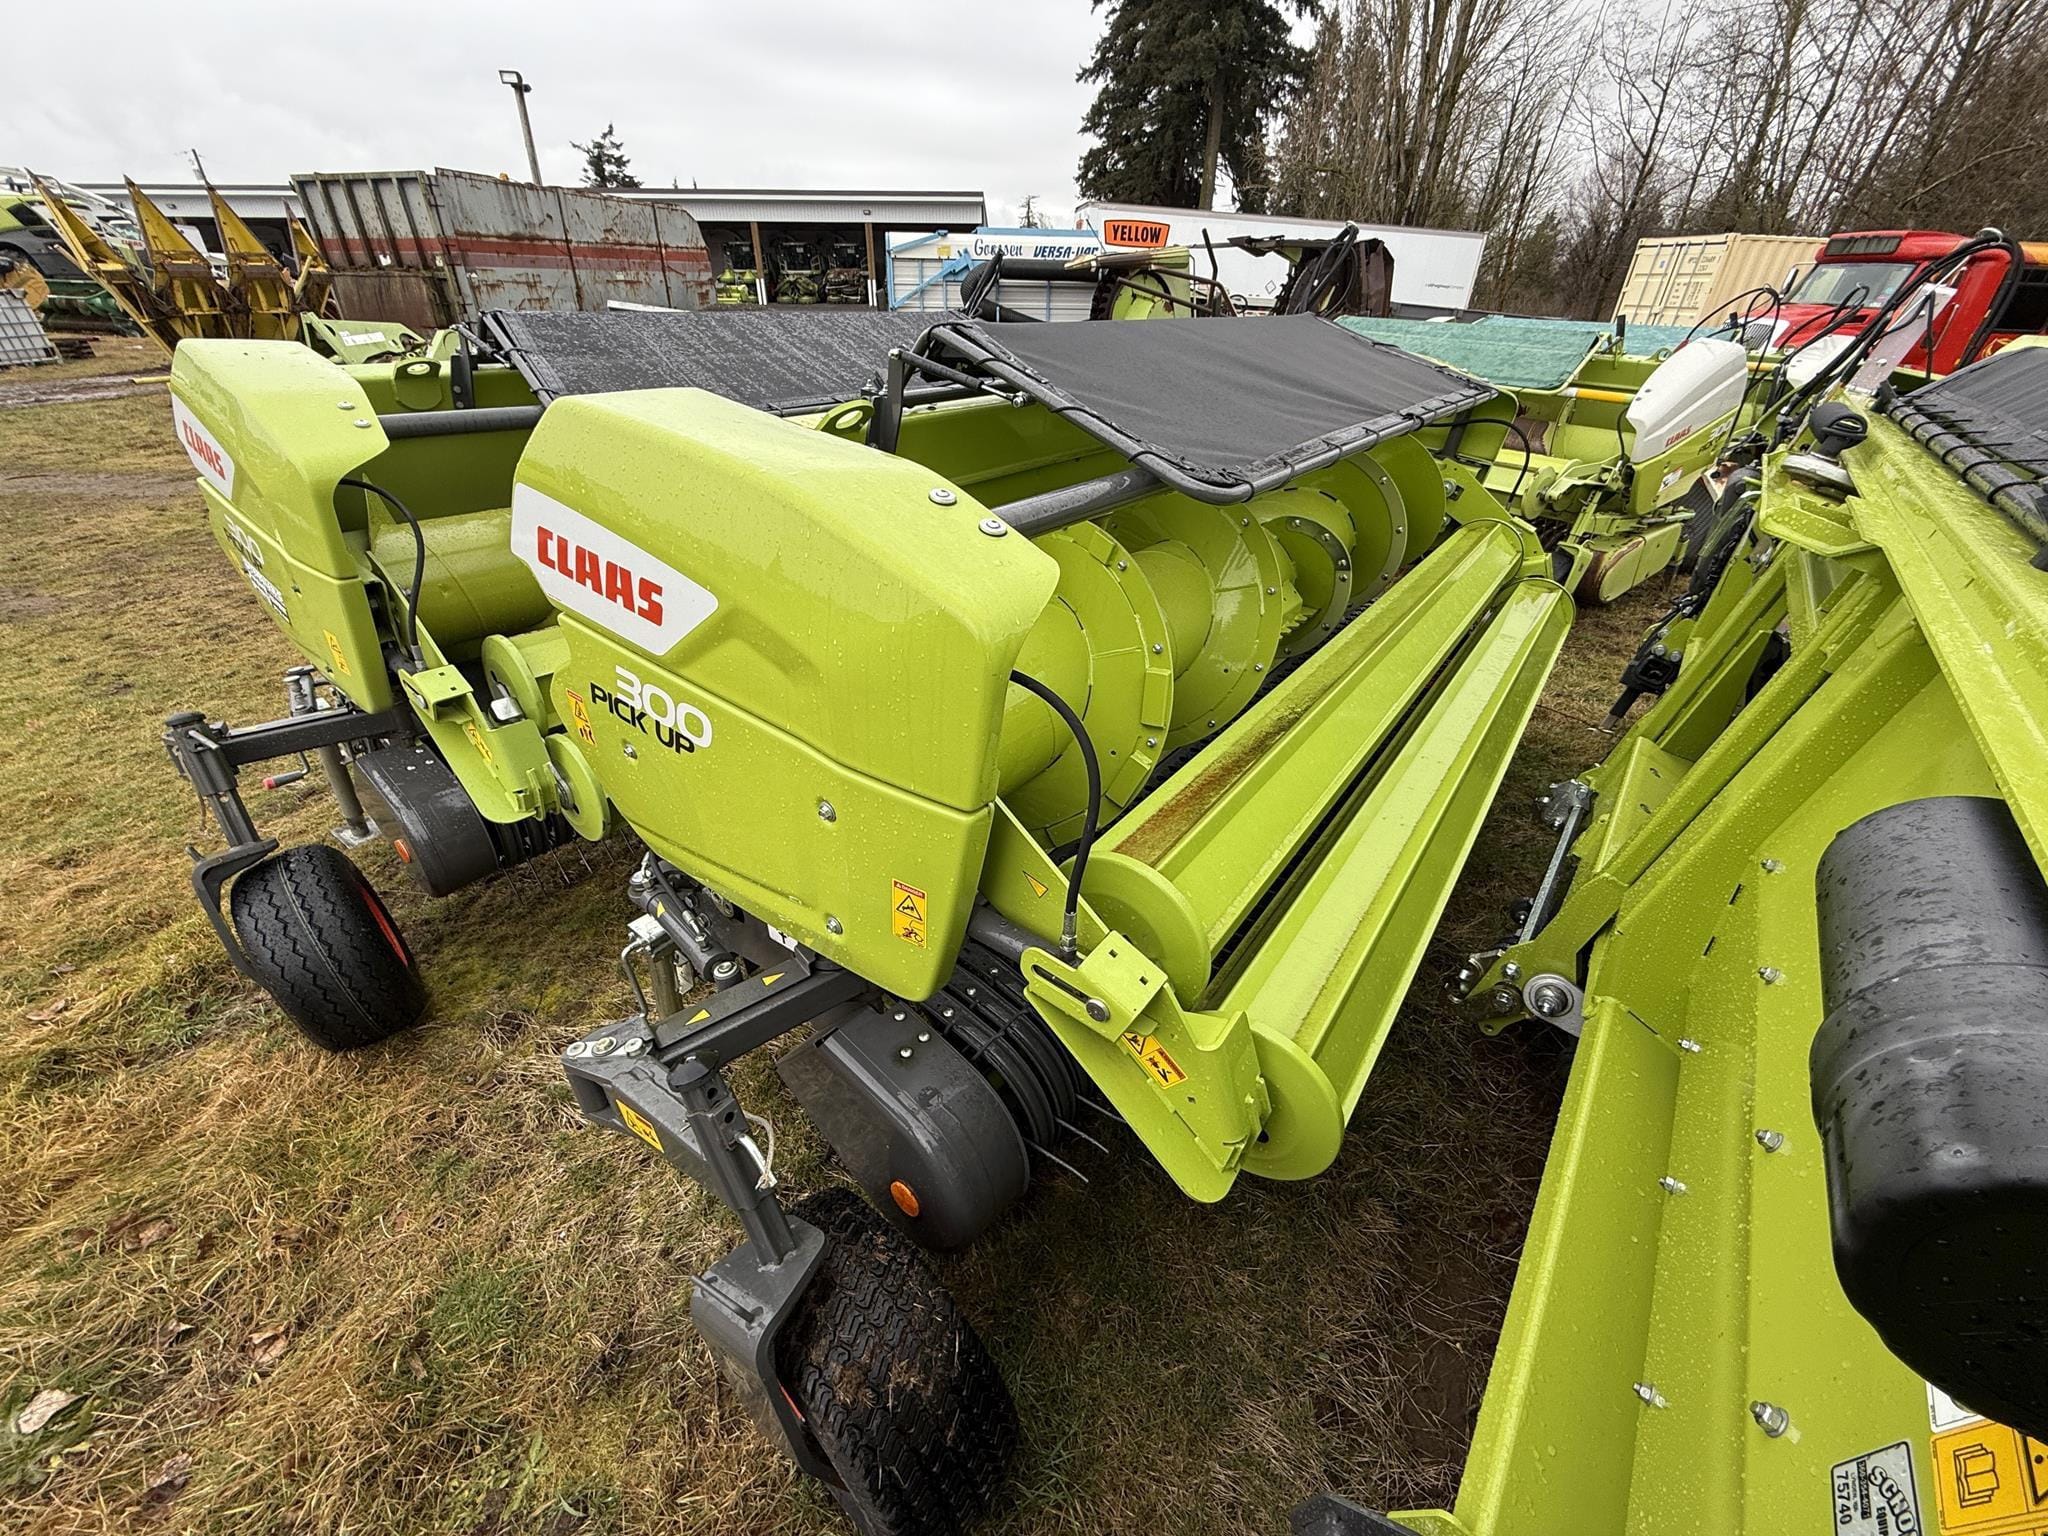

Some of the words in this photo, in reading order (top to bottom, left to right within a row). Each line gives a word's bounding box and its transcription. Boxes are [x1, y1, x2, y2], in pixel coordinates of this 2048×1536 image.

[1112, 224, 1162, 244] YELLOW
[182, 419, 226, 481] CLAAS
[1664, 423, 1693, 448] CLAAS
[537, 525, 663, 627] CLAAS
[590, 682, 648, 735] PICK
[655, 720, 695, 754] UP
[615, 665, 713, 748] 300
[1837, 1470, 1853, 1525] 75740
